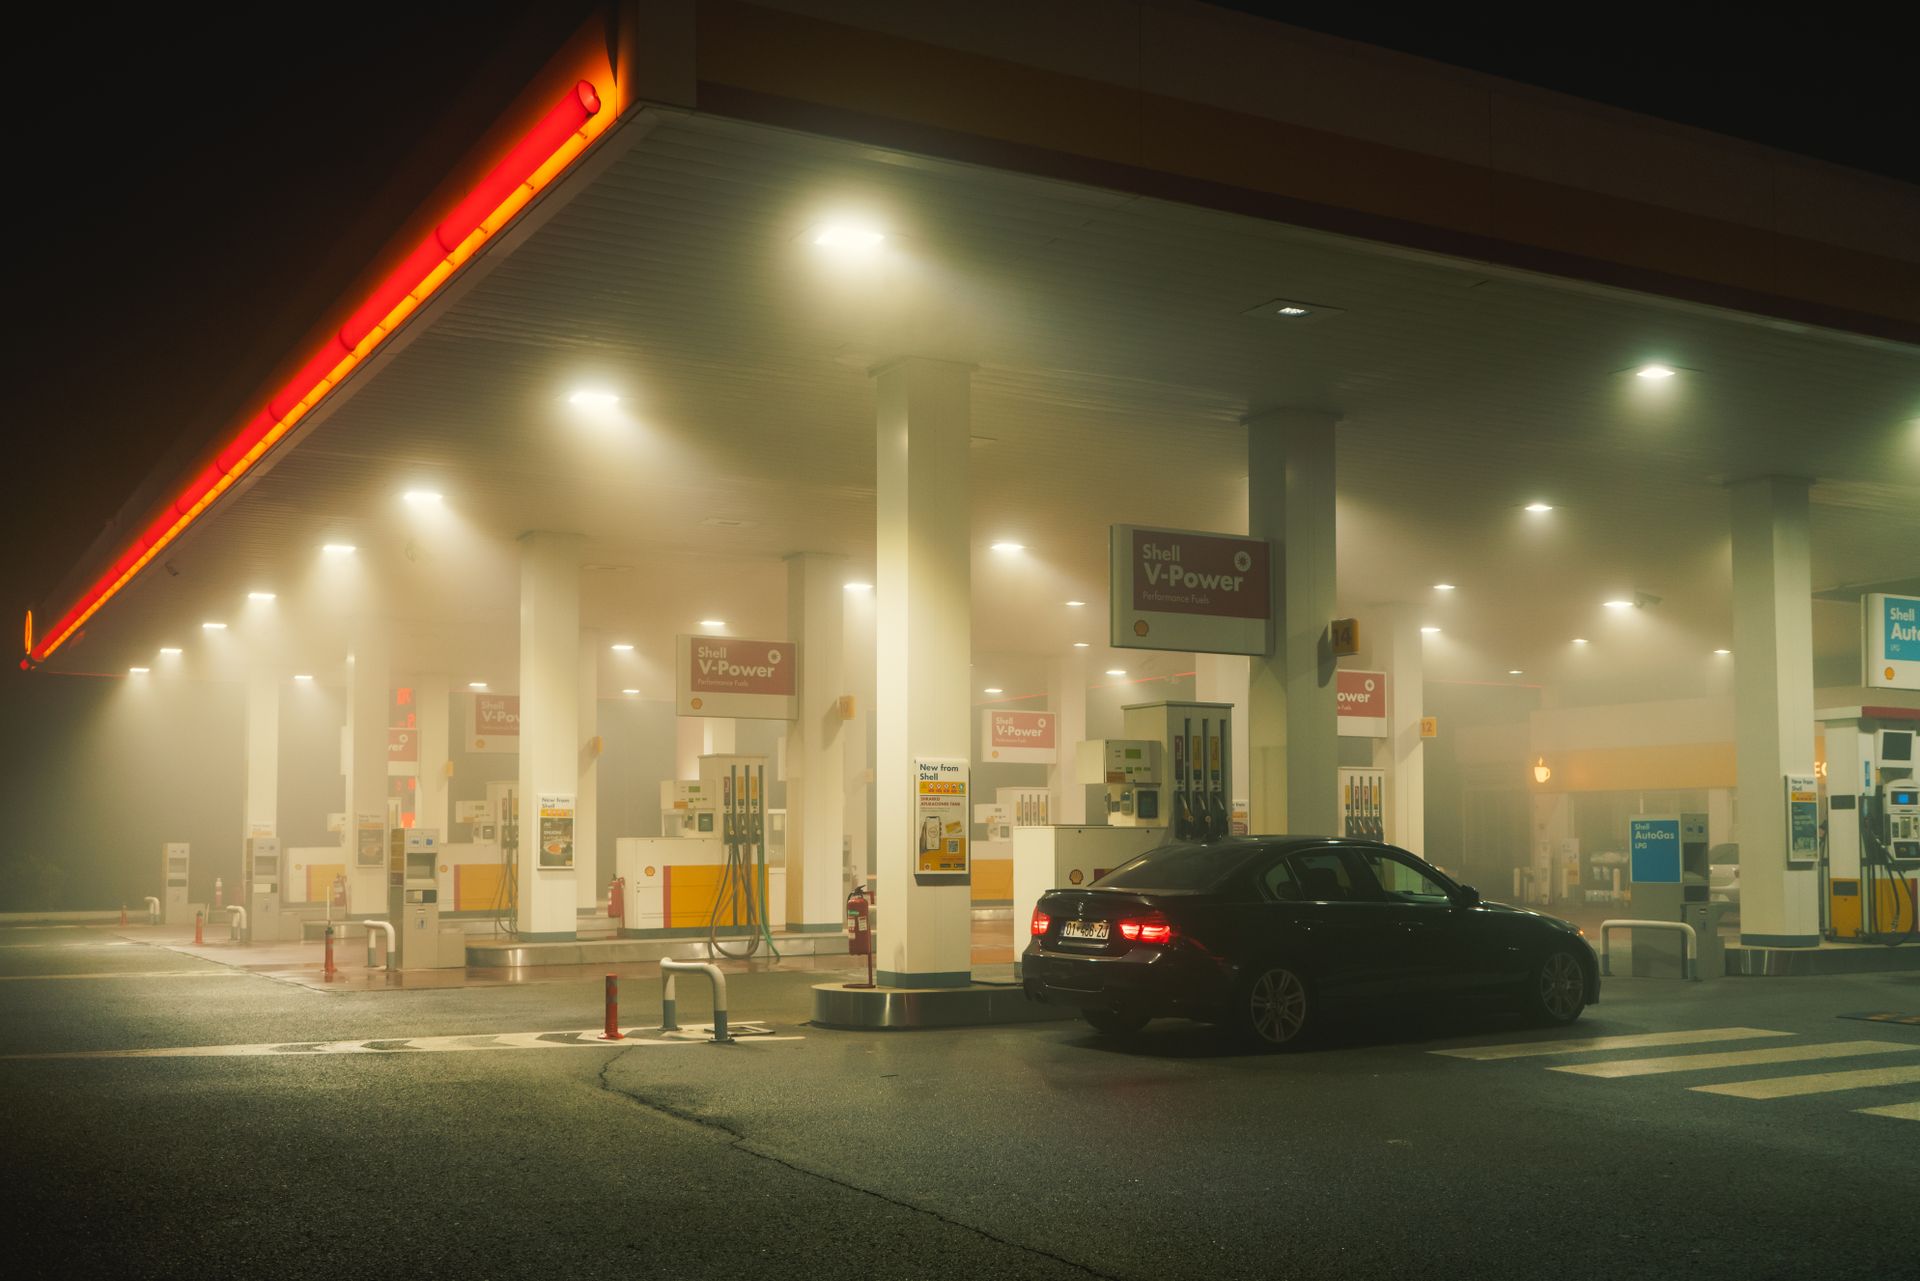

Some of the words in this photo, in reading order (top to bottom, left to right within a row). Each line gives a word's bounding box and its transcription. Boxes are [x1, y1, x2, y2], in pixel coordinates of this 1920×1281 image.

[1143, 544, 1180, 562] Shell
[1144, 562, 1244, 592] V-Power
[1143, 591, 1189, 603] Performance
[1191, 594, 1210, 604] Fuels
[1890, 607, 1915, 621] Shell
[698, 646, 727, 659] Shell
[699, 659, 776, 678] V-Power
[996, 725, 1043, 737] V-Power
[920, 763, 938, 771] New
[941, 763, 959, 772] from
[920, 773, 938, 781] Shell
[1634, 823, 1649, 831] Shell
[1634, 830, 1675, 840] AutoGas
